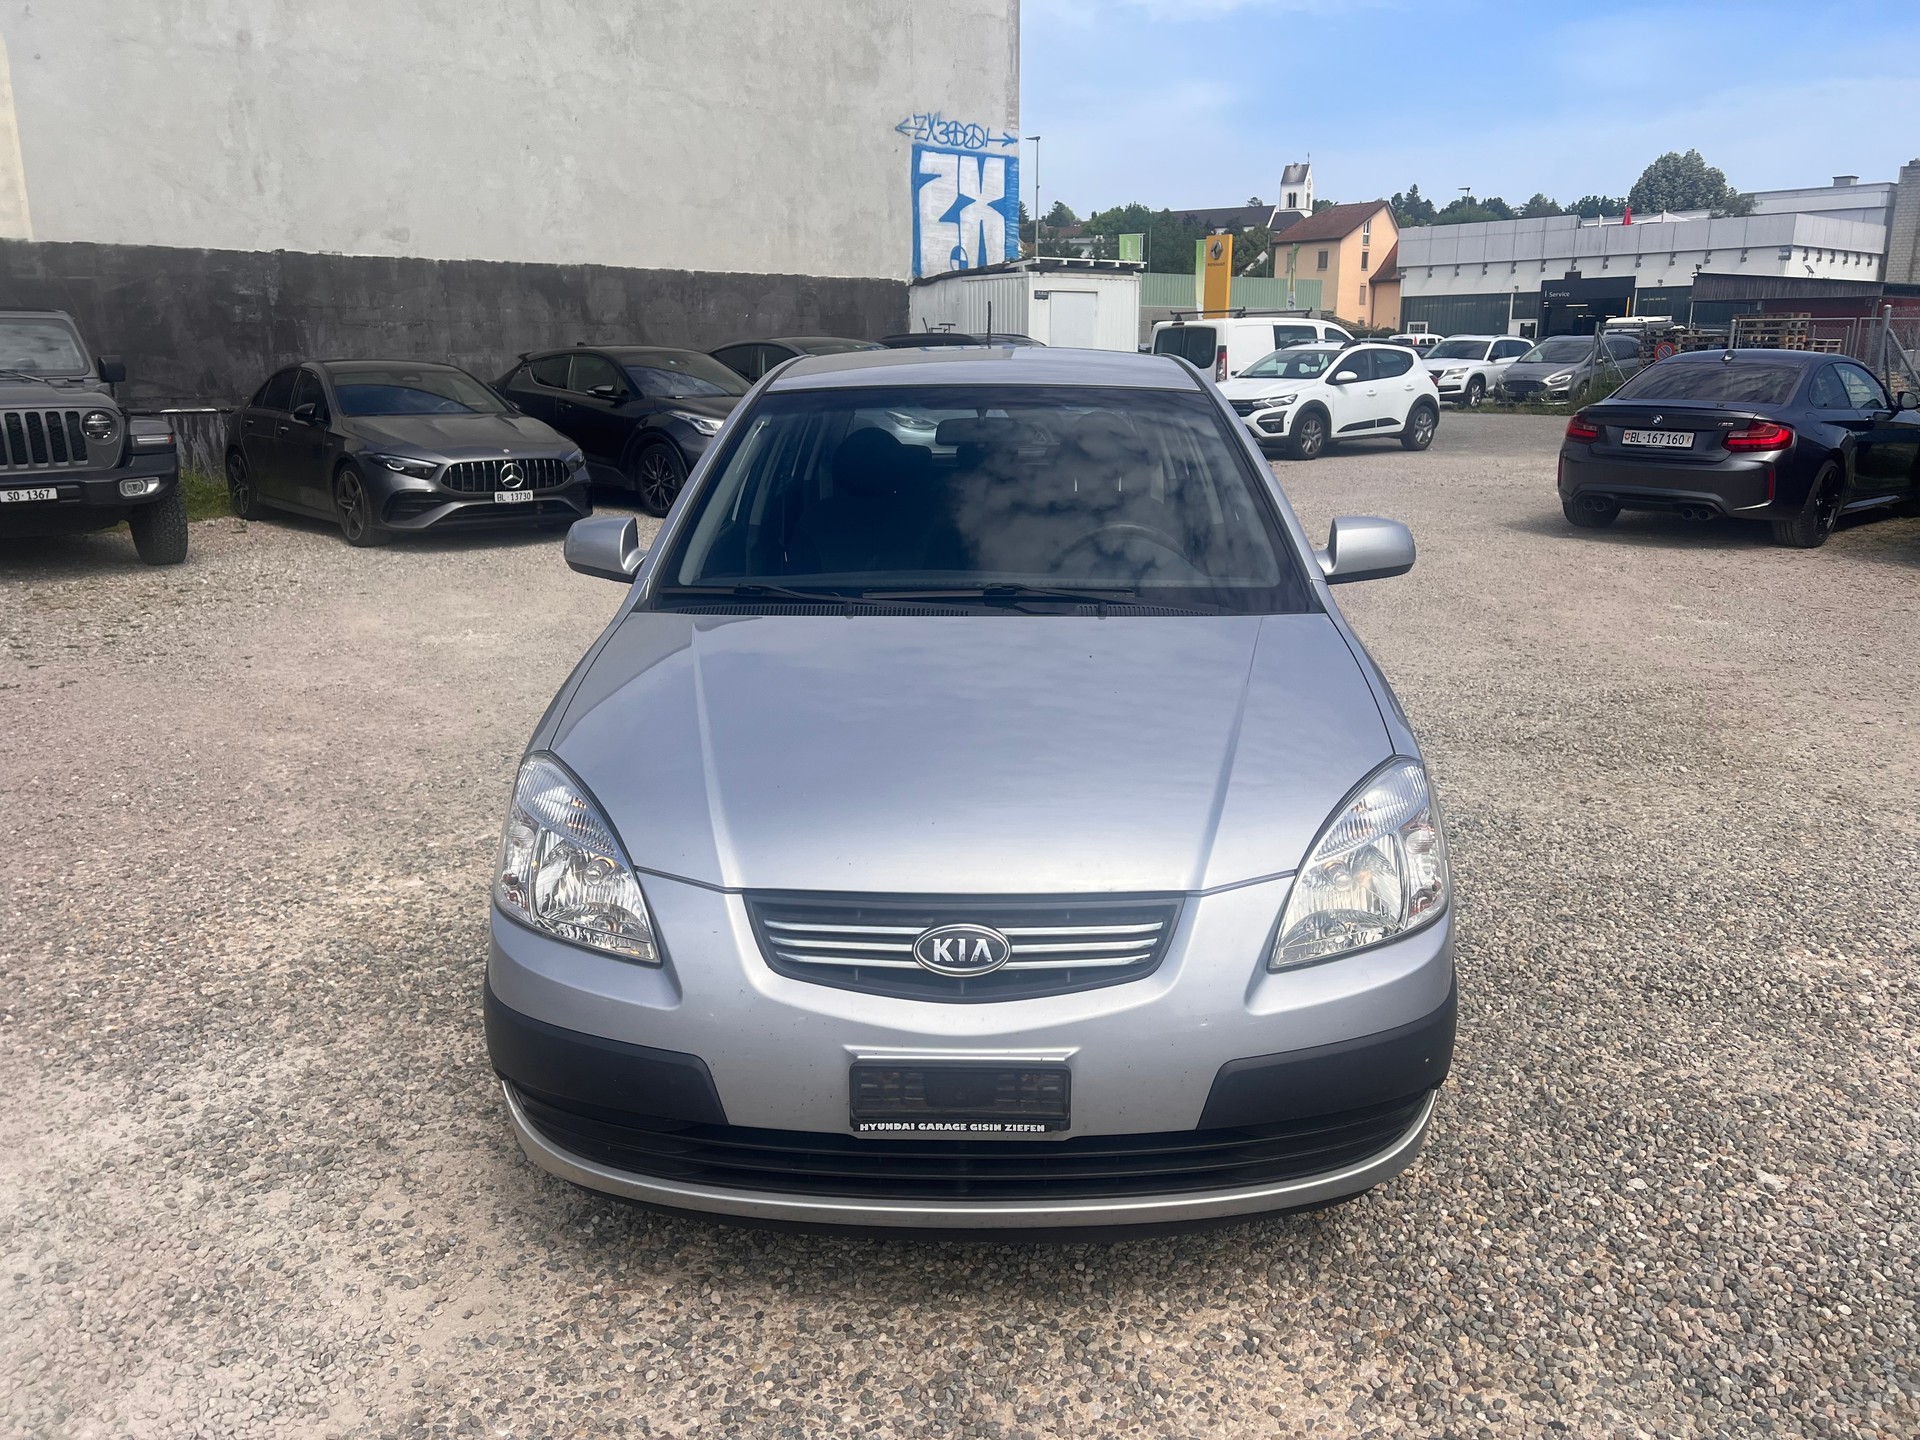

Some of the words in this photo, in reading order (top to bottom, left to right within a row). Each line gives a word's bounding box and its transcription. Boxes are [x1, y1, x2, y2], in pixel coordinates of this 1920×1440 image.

[932, 938, 993, 962] KIA
[859, 1122, 915, 1132] HYUNDAI
[917, 1122, 967, 1132] GARAGE
[969, 1123, 1002, 1132] GISIN
[1004, 1123, 1046, 1133] ZIEFEN
